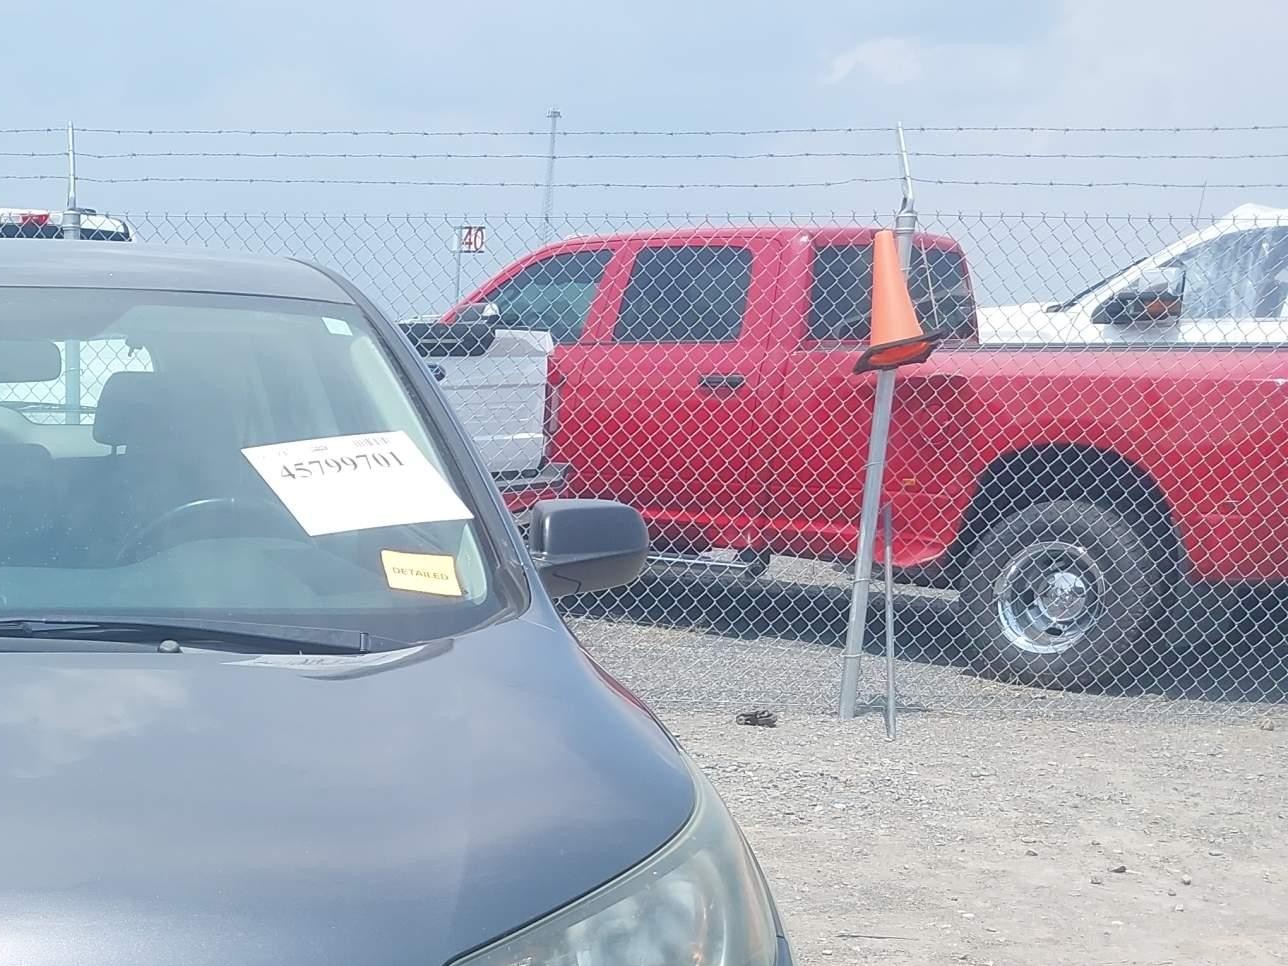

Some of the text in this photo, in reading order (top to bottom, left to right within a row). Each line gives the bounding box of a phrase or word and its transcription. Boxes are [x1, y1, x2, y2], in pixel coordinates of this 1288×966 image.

[462, 227, 484, 251] 40
[280, 451, 406, 480] 45799701
[392, 566, 450, 582] DETAILED
